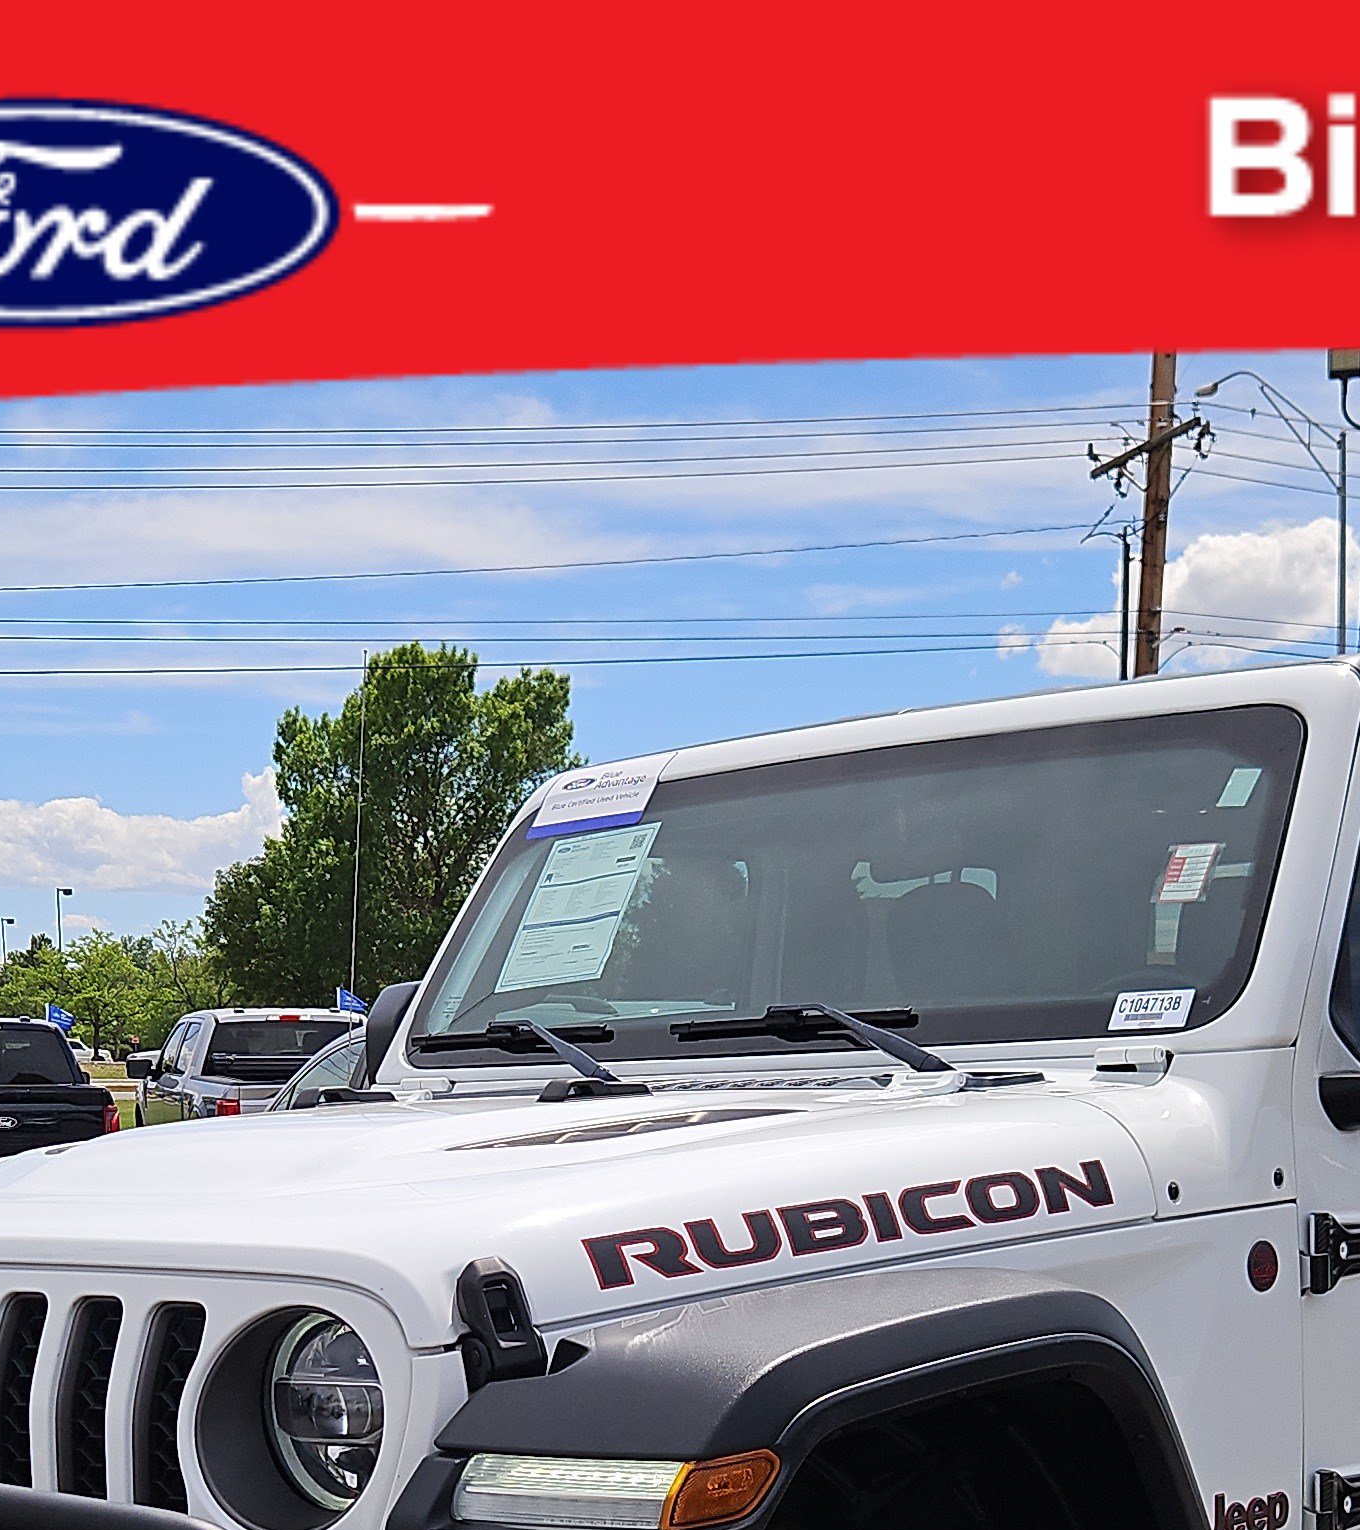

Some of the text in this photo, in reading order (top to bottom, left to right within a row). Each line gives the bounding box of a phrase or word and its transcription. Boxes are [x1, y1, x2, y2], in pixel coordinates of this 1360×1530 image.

[594, 775, 647, 790] Advantage
[601, 770, 624, 779] Blue
[551, 802, 565, 811] Blue
[596, 795, 614, 804] Used
[615, 791, 640, 801] Vehicle
[1118, 996, 1182, 1013] C104713B
[579, 1159, 1115, 1290] RUBICON
